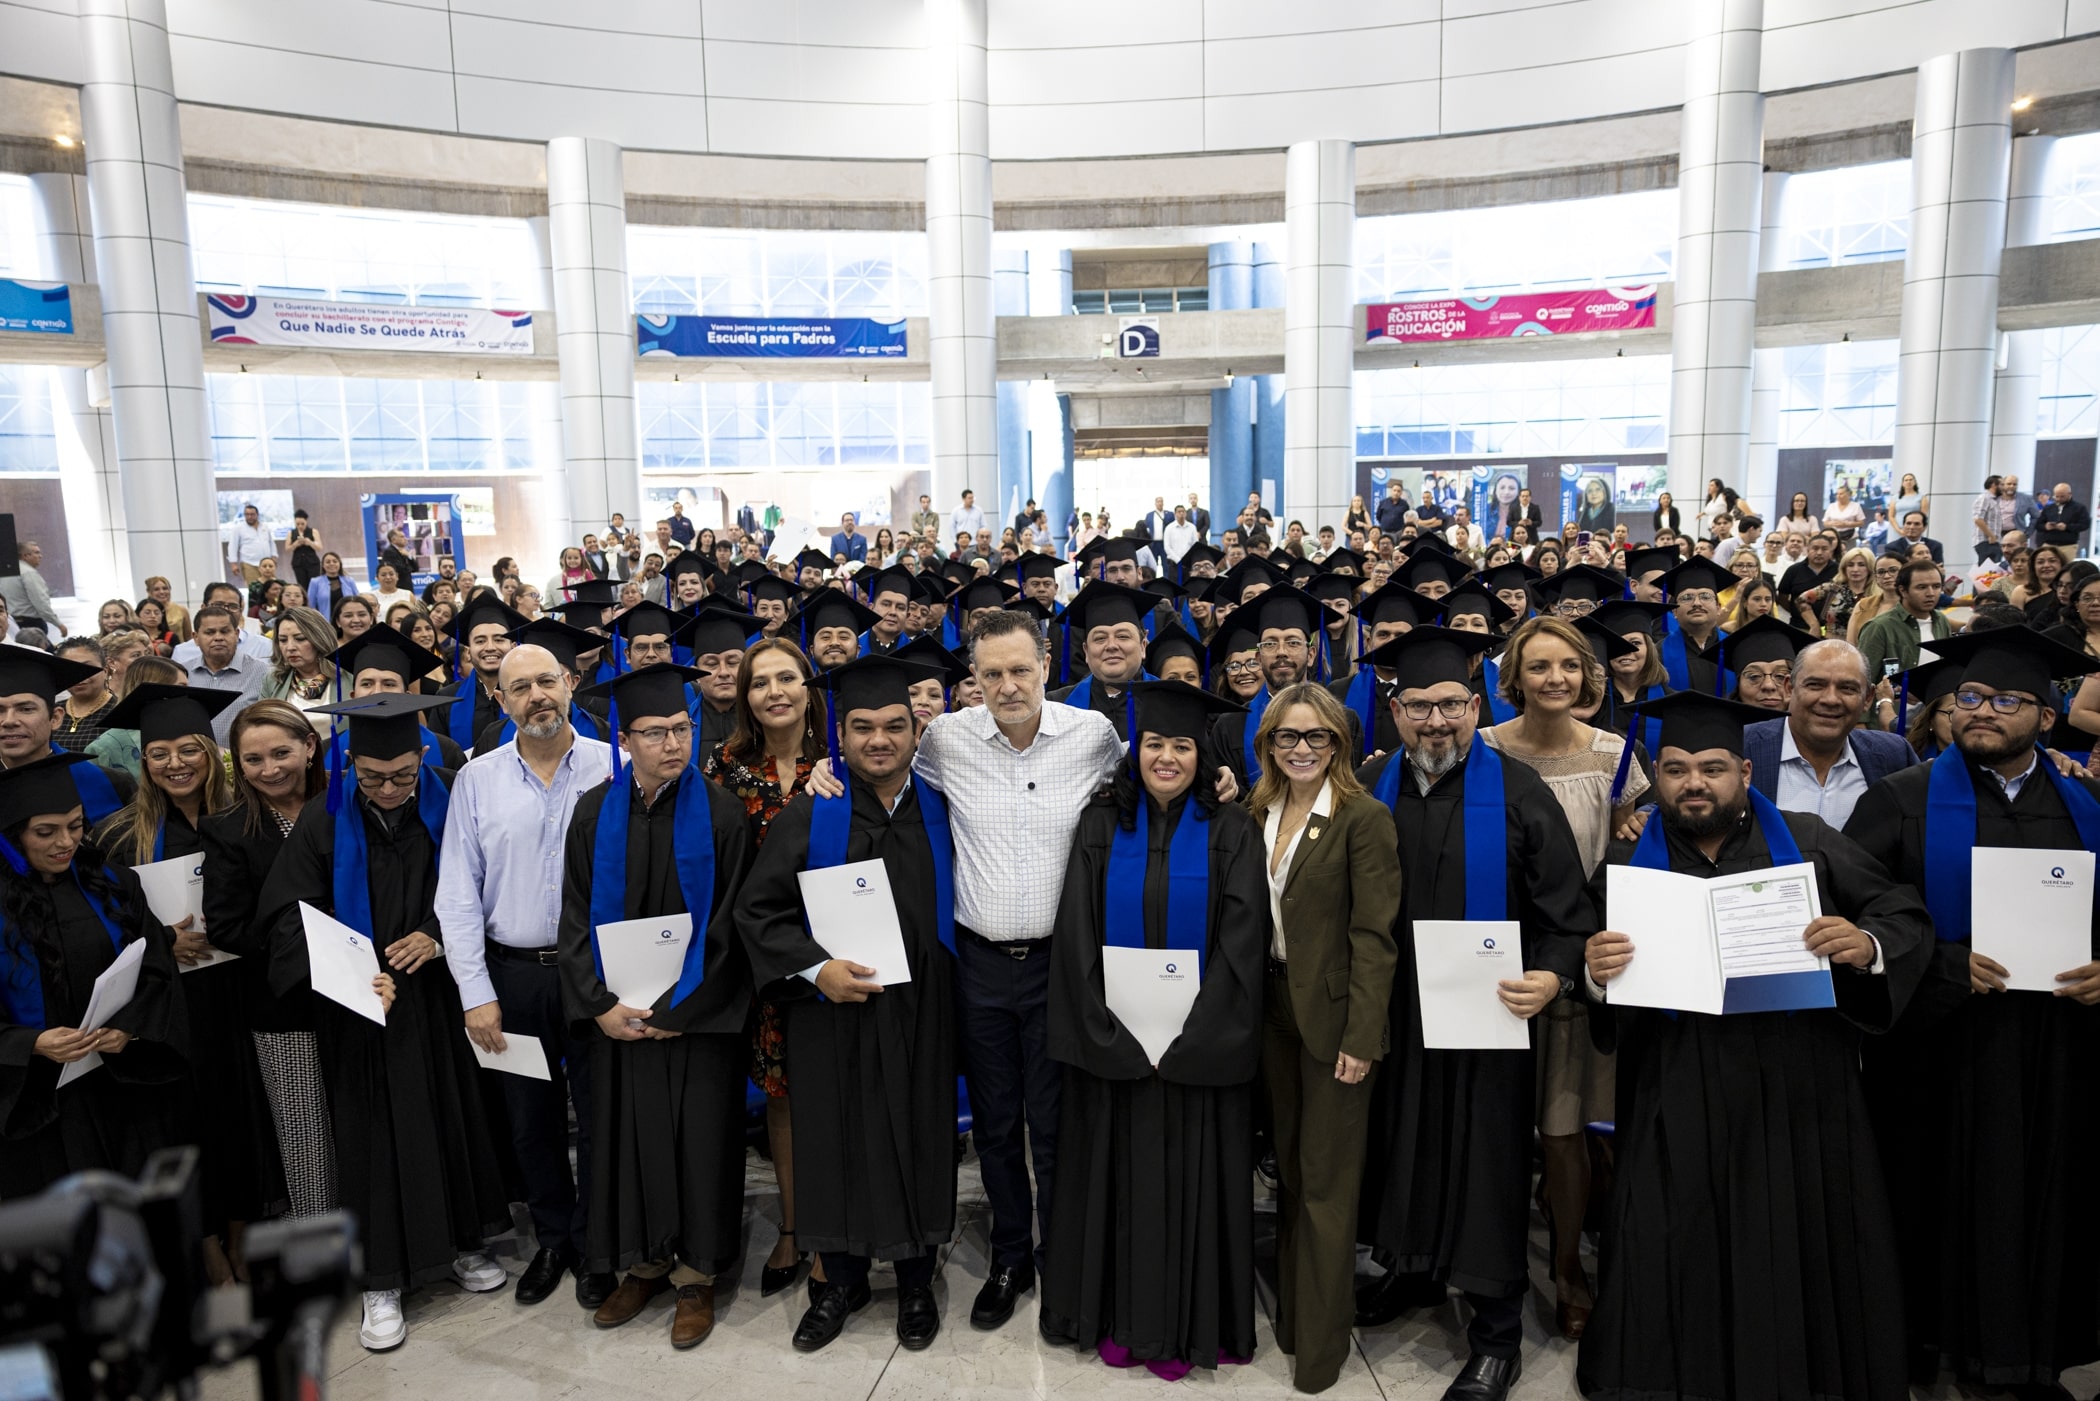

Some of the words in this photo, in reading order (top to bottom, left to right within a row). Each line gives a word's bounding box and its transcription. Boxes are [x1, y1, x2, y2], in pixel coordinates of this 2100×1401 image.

[1585, 301, 1630, 314] CONTIGO
[1387, 309, 1447, 323] ROSTROS
[280, 320, 310, 332] Que
[315, 321, 356, 334] Nadie
[360, 324, 376, 336] Se
[381, 325, 425, 338] Quede
[430, 327, 466, 338] Atrás
[1387, 318, 1466, 335] EDUCACIÓN
[707, 331, 757, 344] Escuela
[760, 334, 789, 347] para
[792, 332, 836, 345] Padres
[1123, 331, 1146, 356] D
